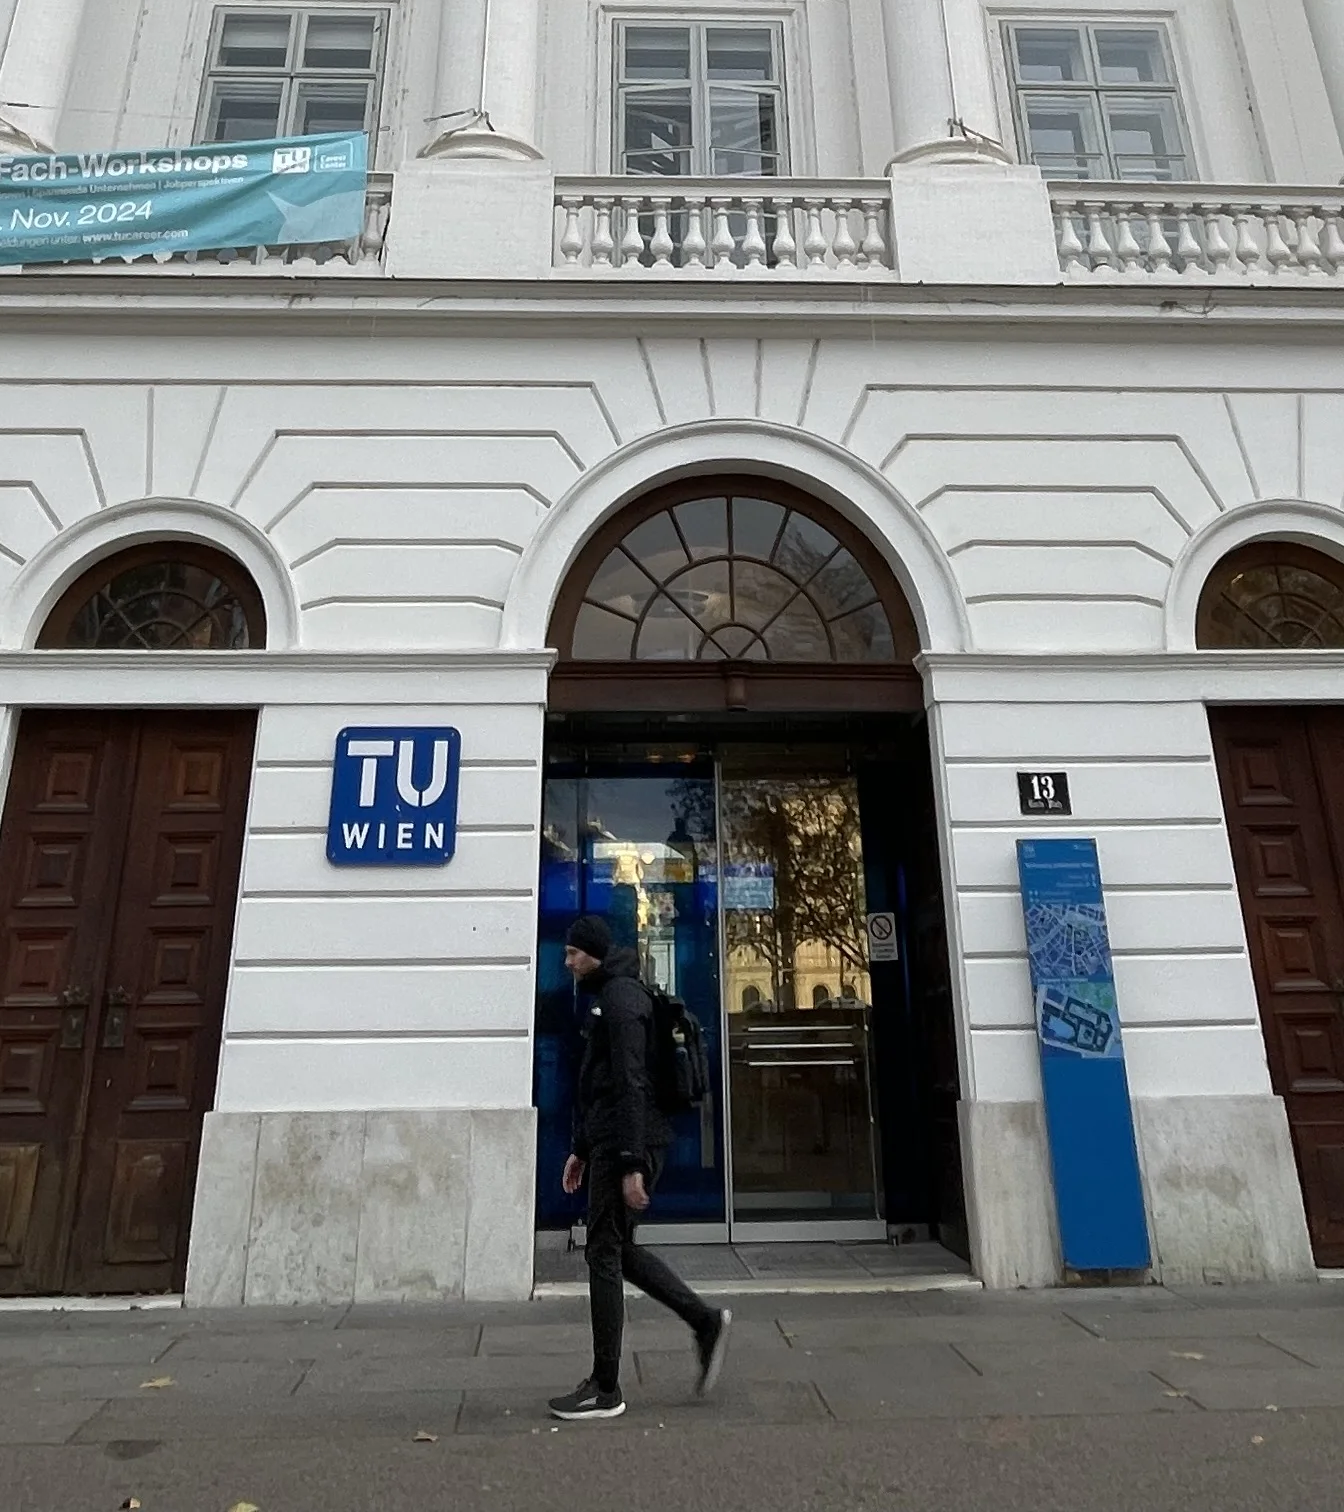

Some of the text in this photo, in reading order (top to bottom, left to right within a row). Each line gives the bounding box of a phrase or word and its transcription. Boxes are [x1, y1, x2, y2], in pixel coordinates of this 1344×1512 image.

[10, 208, 71, 231] Nov.
[77, 200, 153, 225] 2024
[347, 740, 449, 807] TU
[1031, 775, 1055, 799] 13
[342, 823, 444, 849] WIEN
